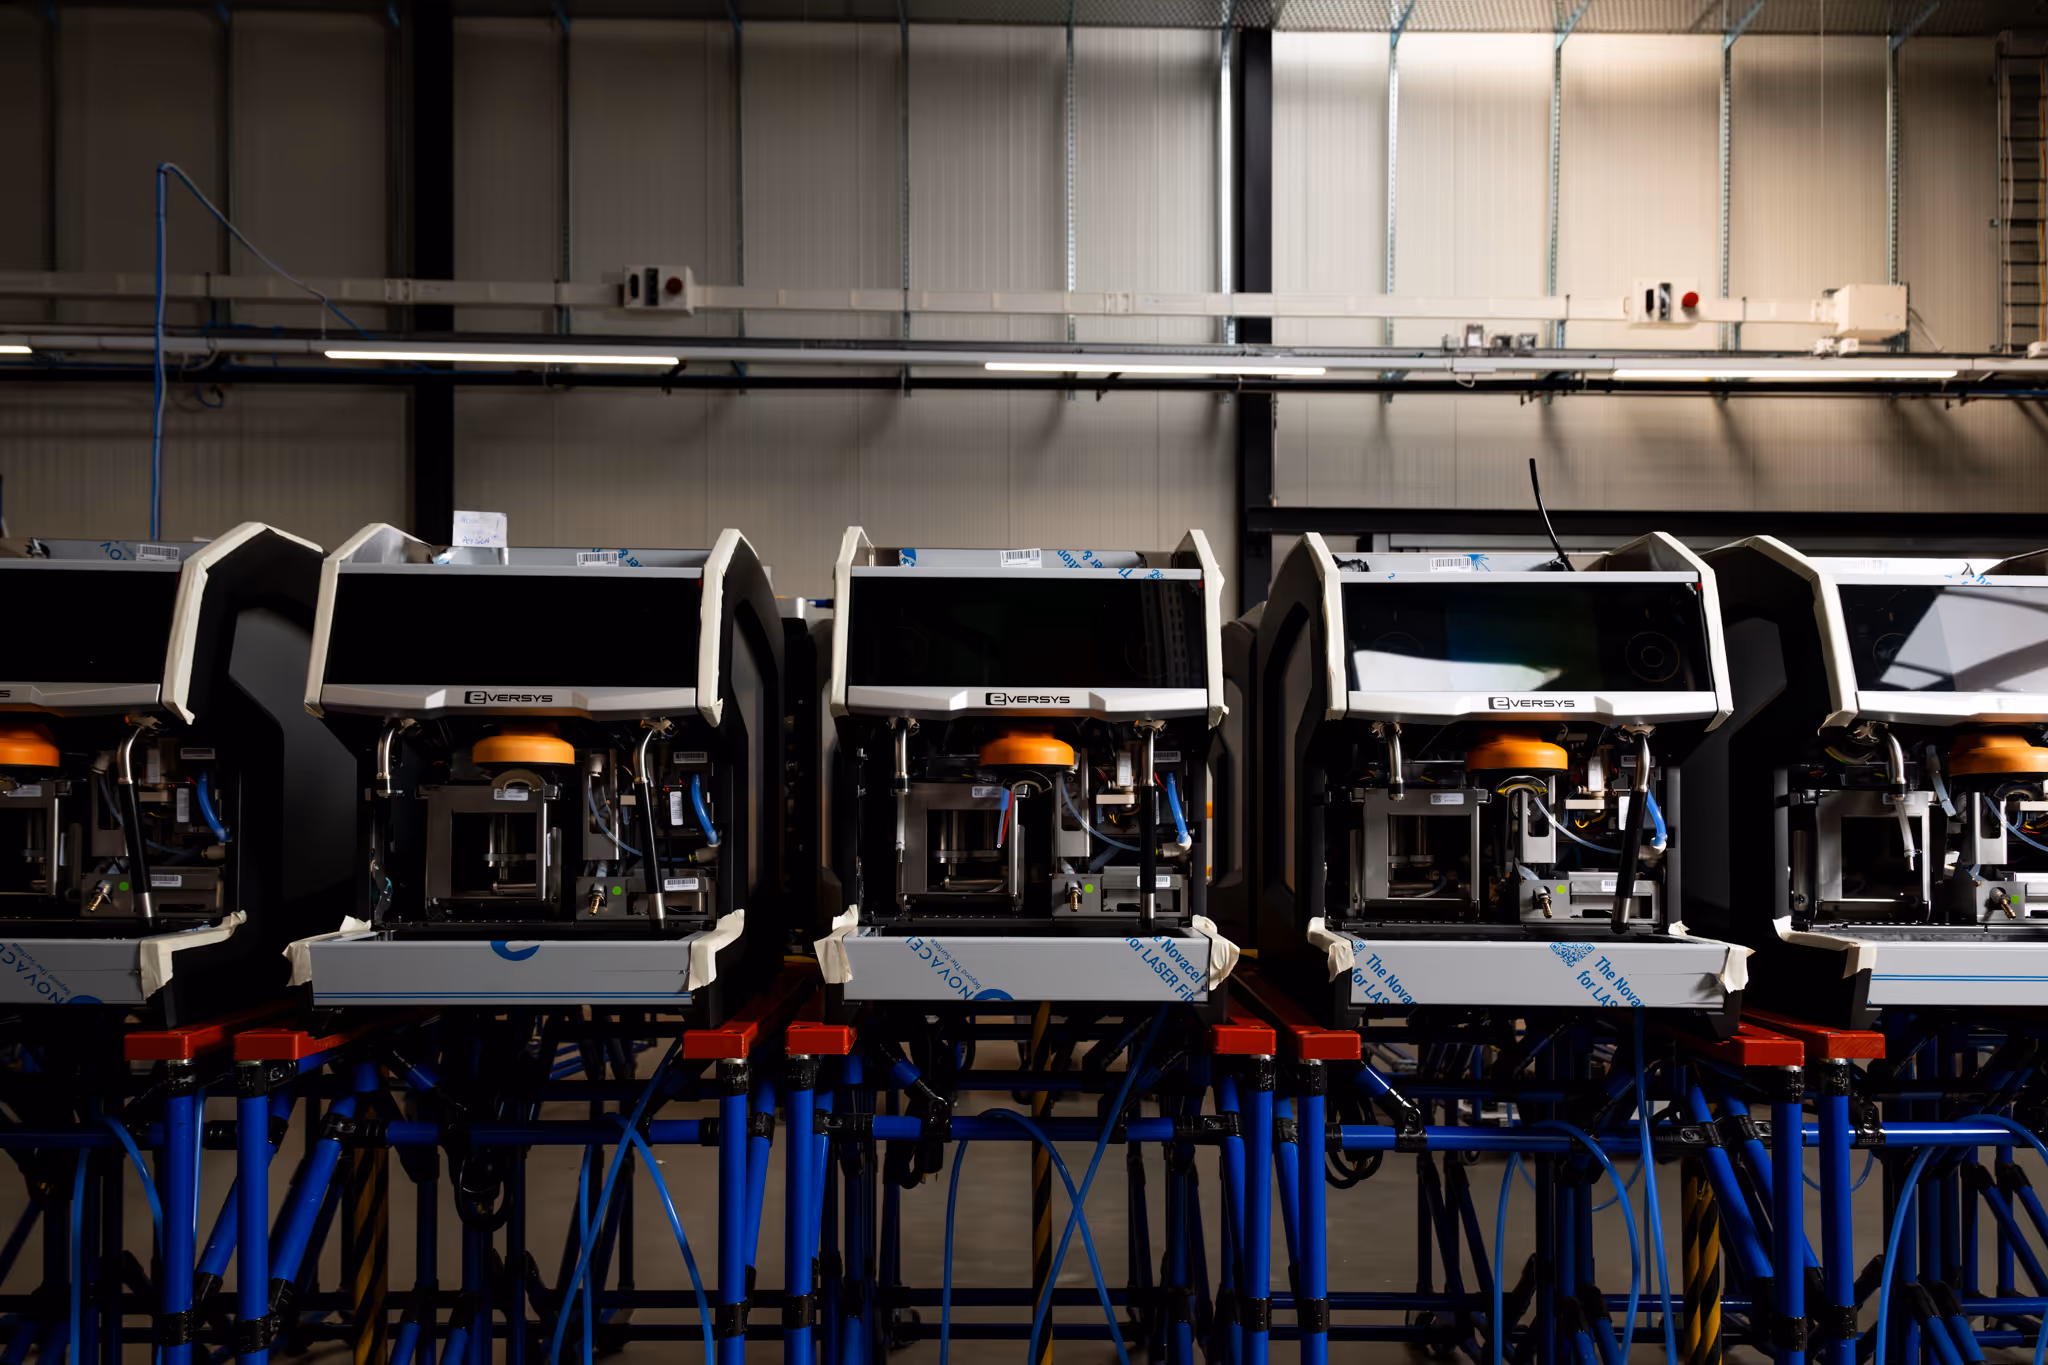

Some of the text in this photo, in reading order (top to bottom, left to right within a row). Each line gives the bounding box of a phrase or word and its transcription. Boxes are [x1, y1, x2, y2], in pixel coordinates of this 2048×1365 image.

[930, 938, 981, 990] Beyond The Surface
[1141, 948, 1179, 988] LASER
[1161, 938, 1206, 984] Novacel
[1366, 953, 1387, 979] The
[1595, 955, 1616, 981] The
[1576, 970, 1596, 990] for
